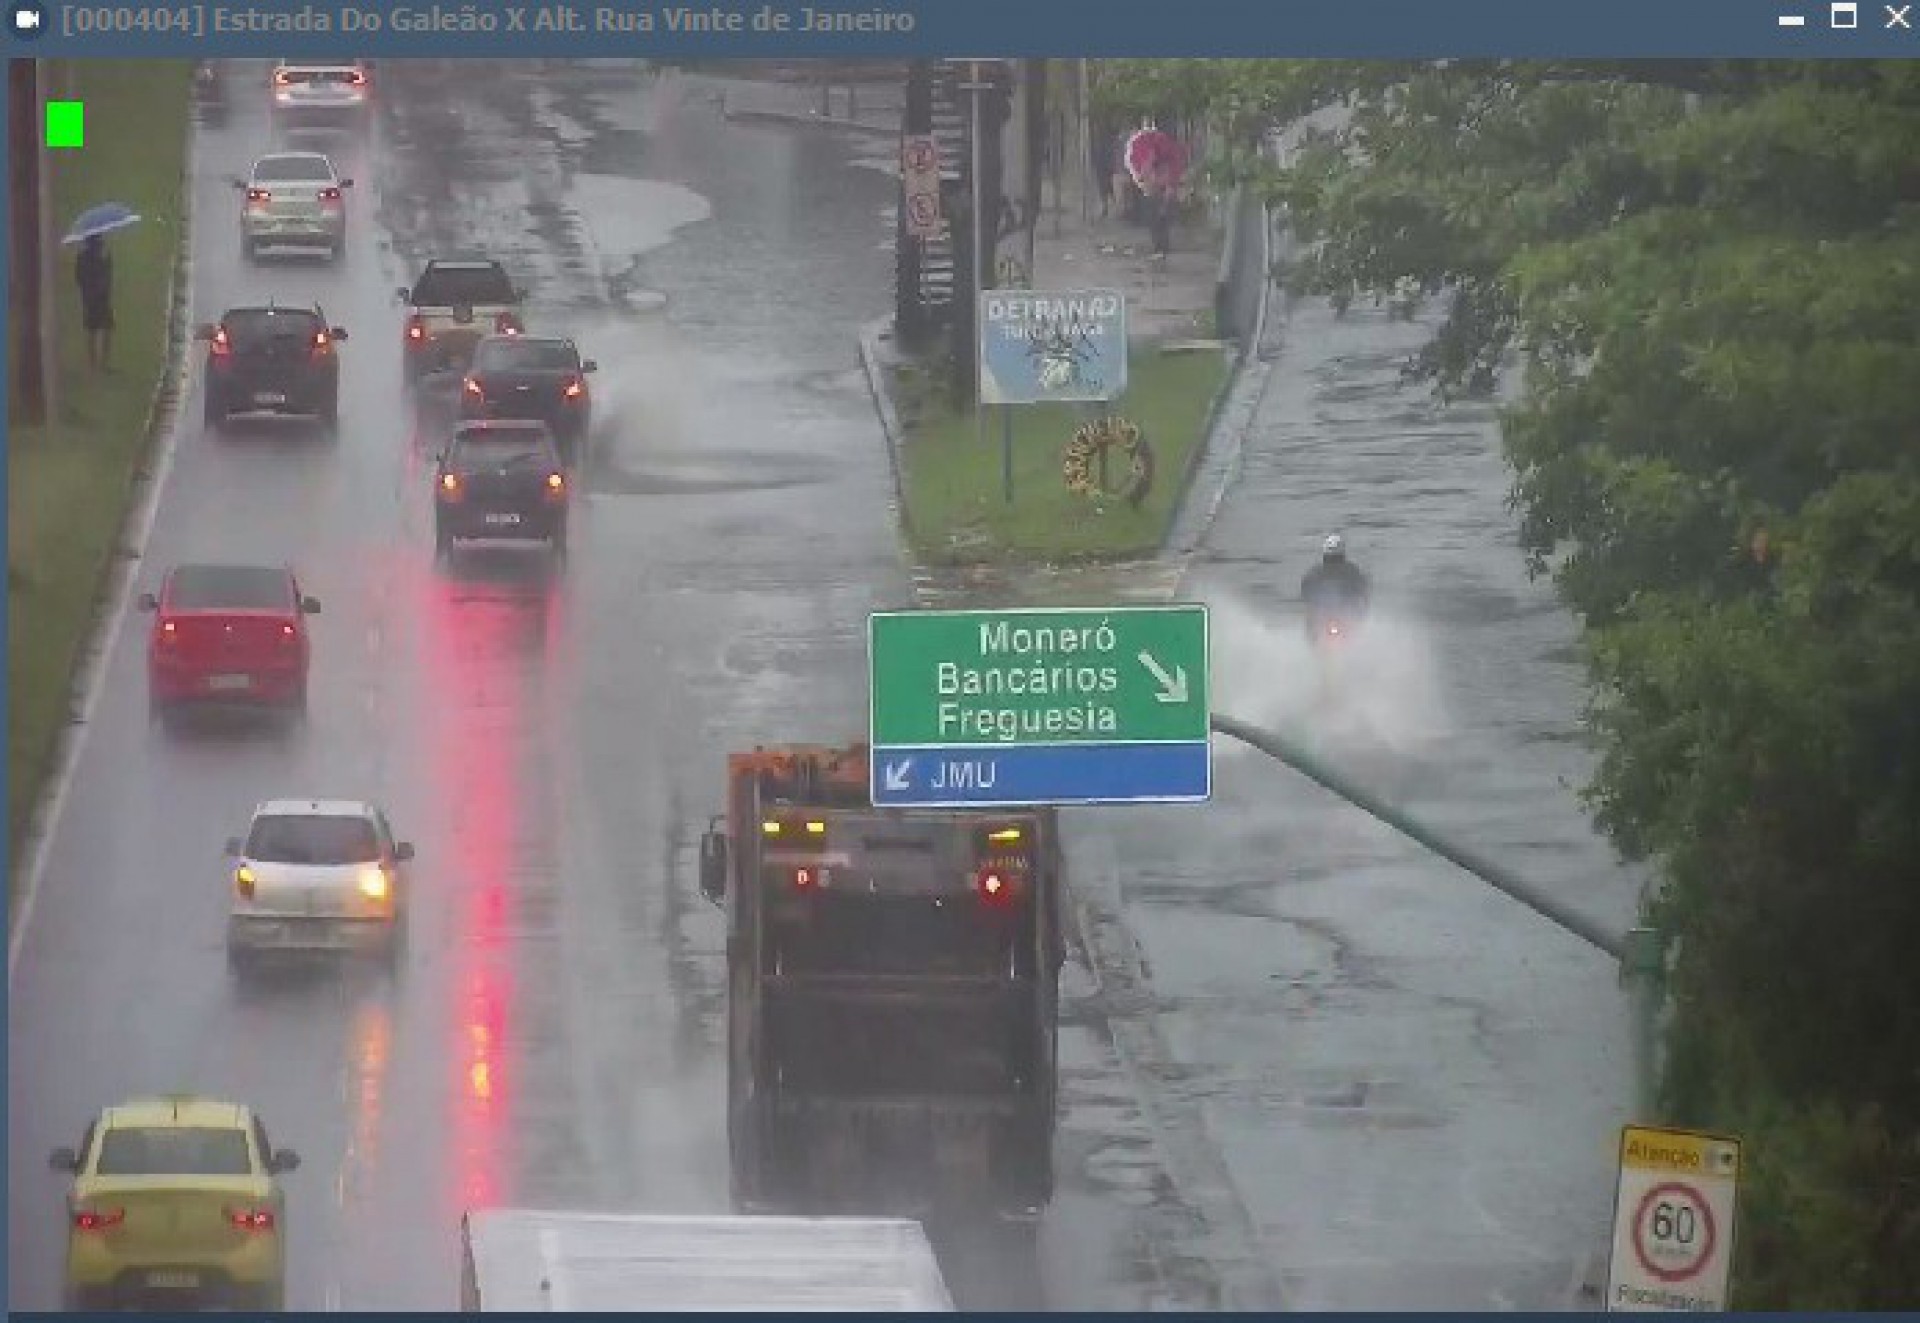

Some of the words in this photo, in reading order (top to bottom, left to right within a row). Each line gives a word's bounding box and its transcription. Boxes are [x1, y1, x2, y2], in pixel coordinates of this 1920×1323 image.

[979, 617, 1117, 656] Moneró
[937, 660, 1118, 696] Bancários
[938, 701, 1118, 741] Freguesia
[930, 760, 997, 789] JMU
[1654, 1201, 1694, 1244] 60
